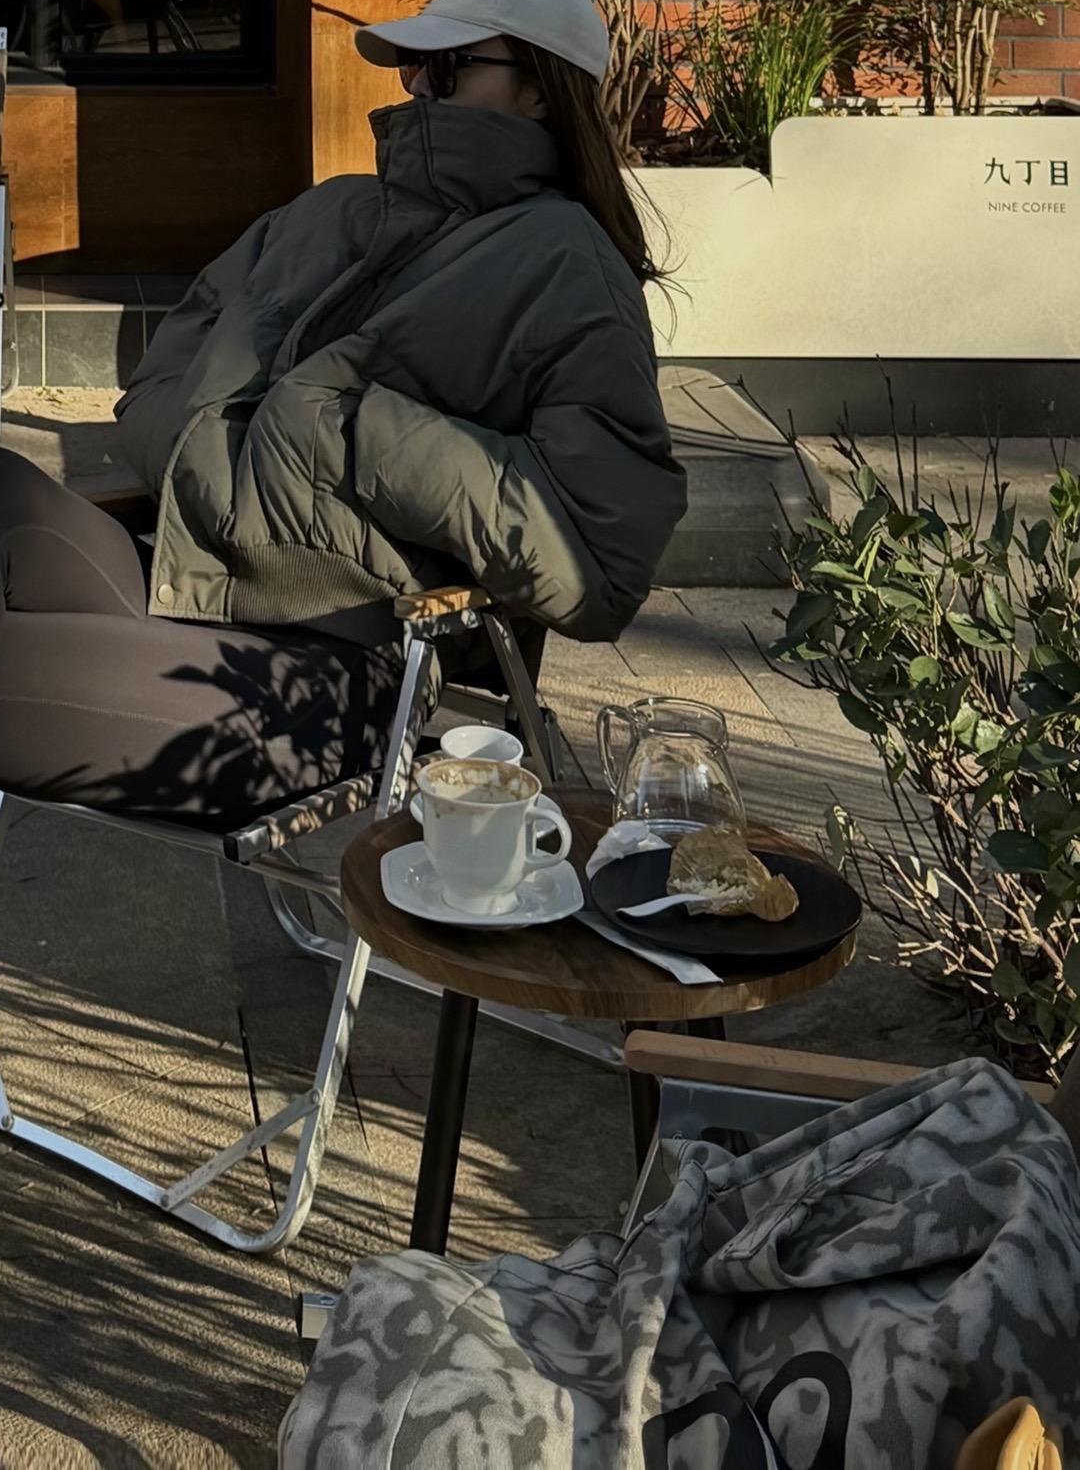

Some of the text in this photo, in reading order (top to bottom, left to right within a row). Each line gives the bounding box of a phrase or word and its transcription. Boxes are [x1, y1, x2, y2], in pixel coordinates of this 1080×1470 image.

[984, 157, 1068, 186] 九丁目
[988, 201, 1066, 213] NINE COFFEE
